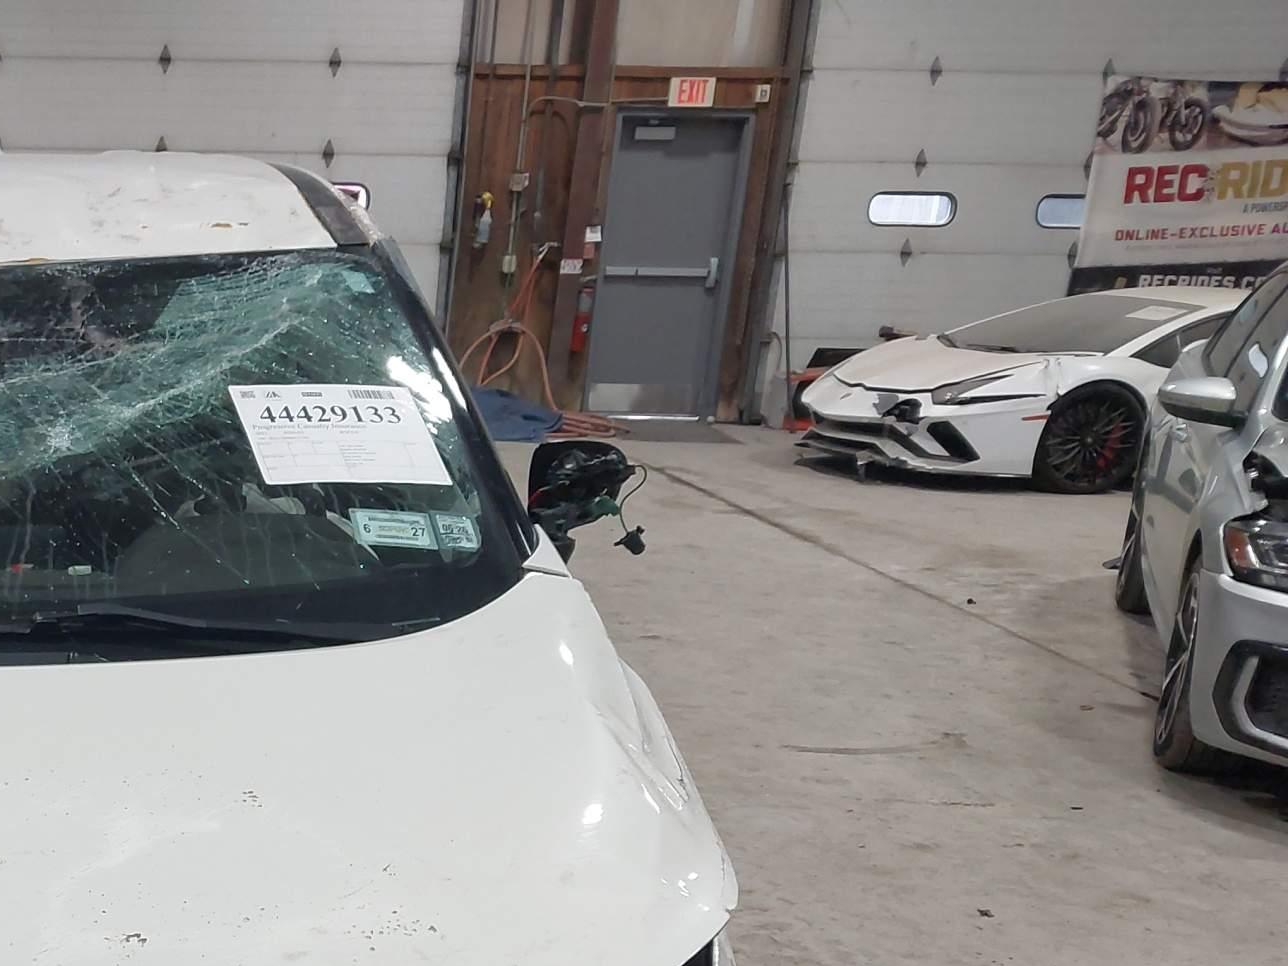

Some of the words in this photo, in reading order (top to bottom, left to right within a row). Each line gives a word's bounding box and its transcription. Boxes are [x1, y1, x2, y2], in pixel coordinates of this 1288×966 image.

[678, 79, 709, 104] EXIT
[1124, 164, 1209, 204] REC
[1114, 223, 1267, 241] ONLINE-EXCLUSIVE
[259, 405, 402, 424] 44429133
[363, 523, 372, 534] 6
[410, 527, 426, 537] 27
